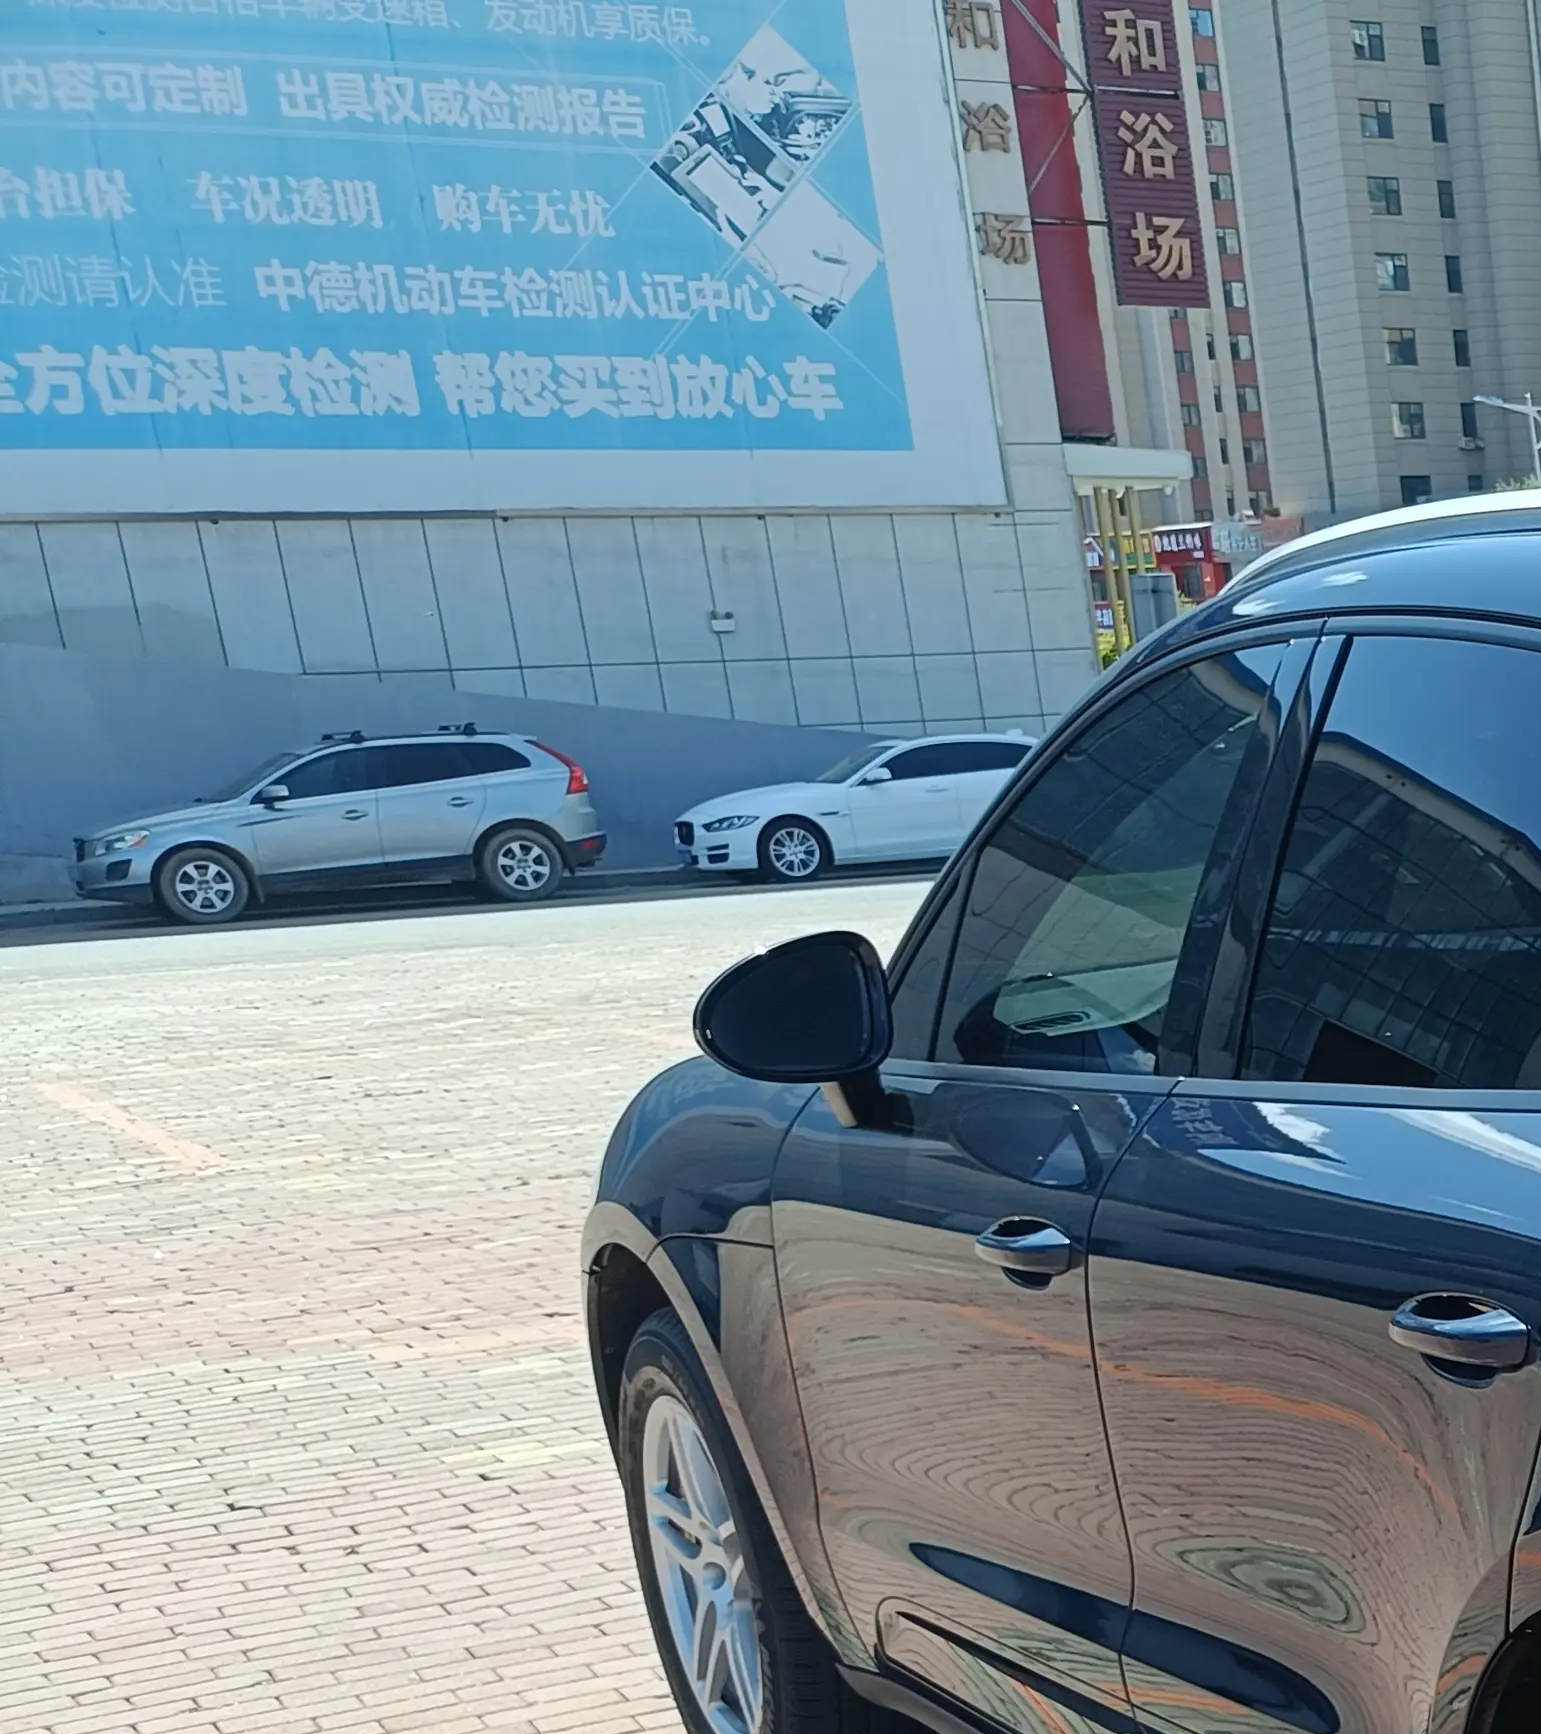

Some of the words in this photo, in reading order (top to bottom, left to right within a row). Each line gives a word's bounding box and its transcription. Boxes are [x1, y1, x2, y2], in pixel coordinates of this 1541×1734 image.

[0, 57, 249, 117] 内容可定制
[277, 68, 647, 139] 出具权威检测报告
[1102, 8, 1193, 281] 和浴场
[186, 170, 384, 229] 车况透明
[432, 184, 616, 238] 购车无忧
[254, 258, 777, 323] 中德机动车检测认证中心
[434, 350, 845, 421] 帮您买到放心车
